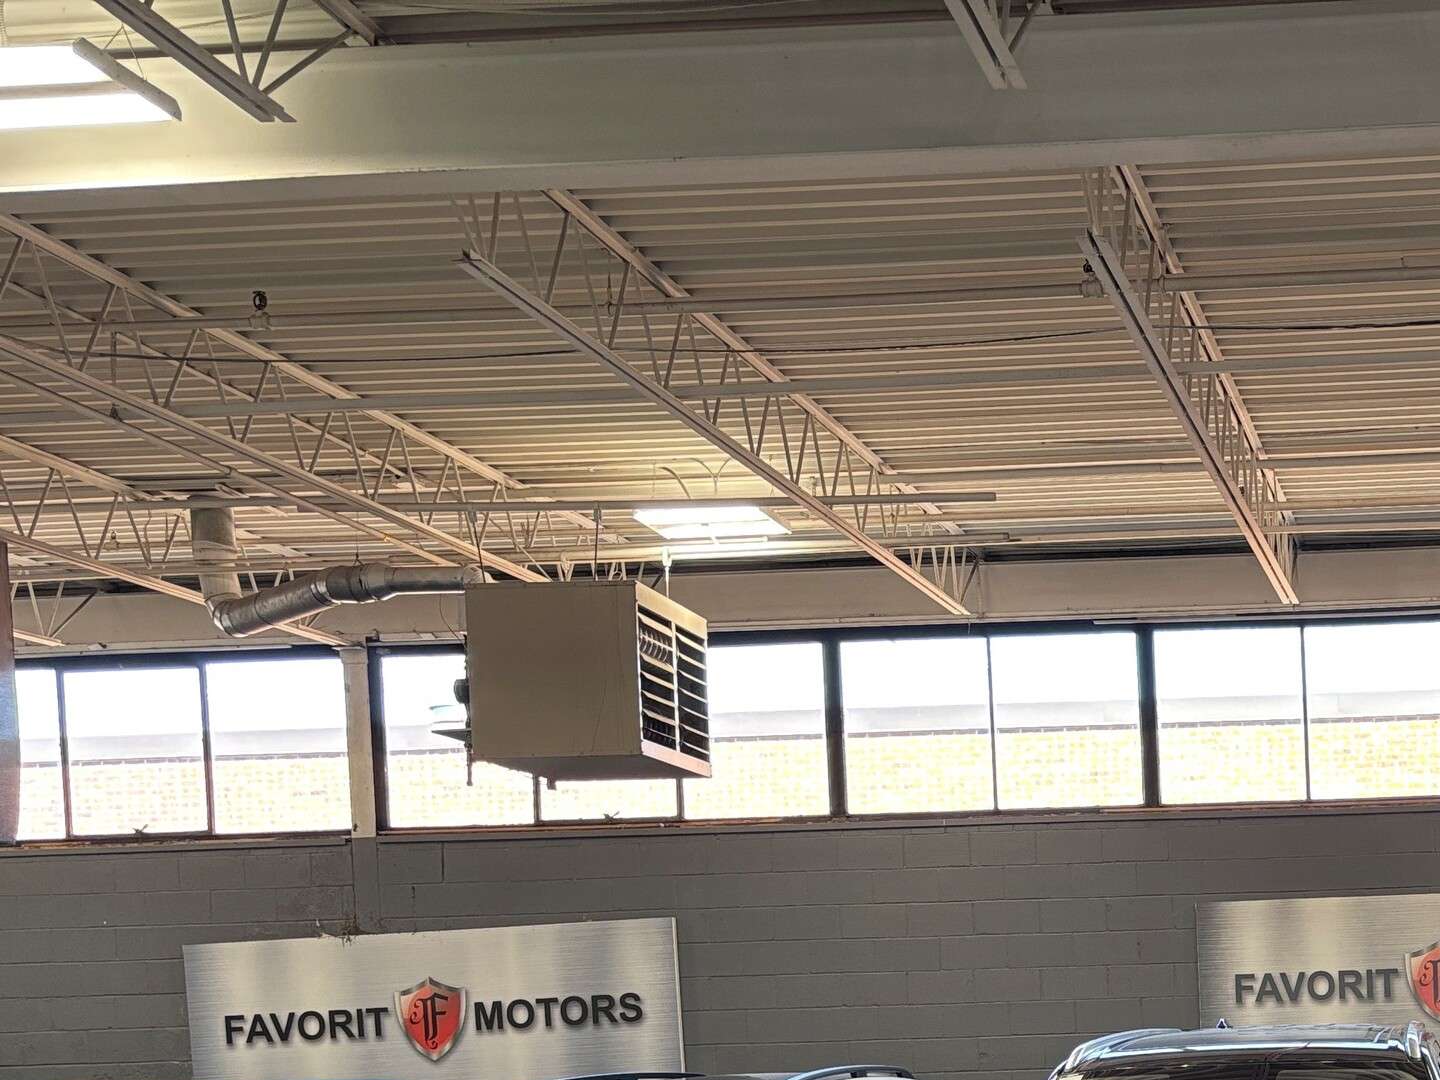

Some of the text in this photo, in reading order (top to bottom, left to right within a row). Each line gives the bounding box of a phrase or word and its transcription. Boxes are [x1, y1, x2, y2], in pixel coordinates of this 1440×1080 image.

[1235, 967, 1398, 1004] FAVORIT
[224, 1006, 389, 1044] FAVORIT
[474, 992, 643, 1031] MOTORS
